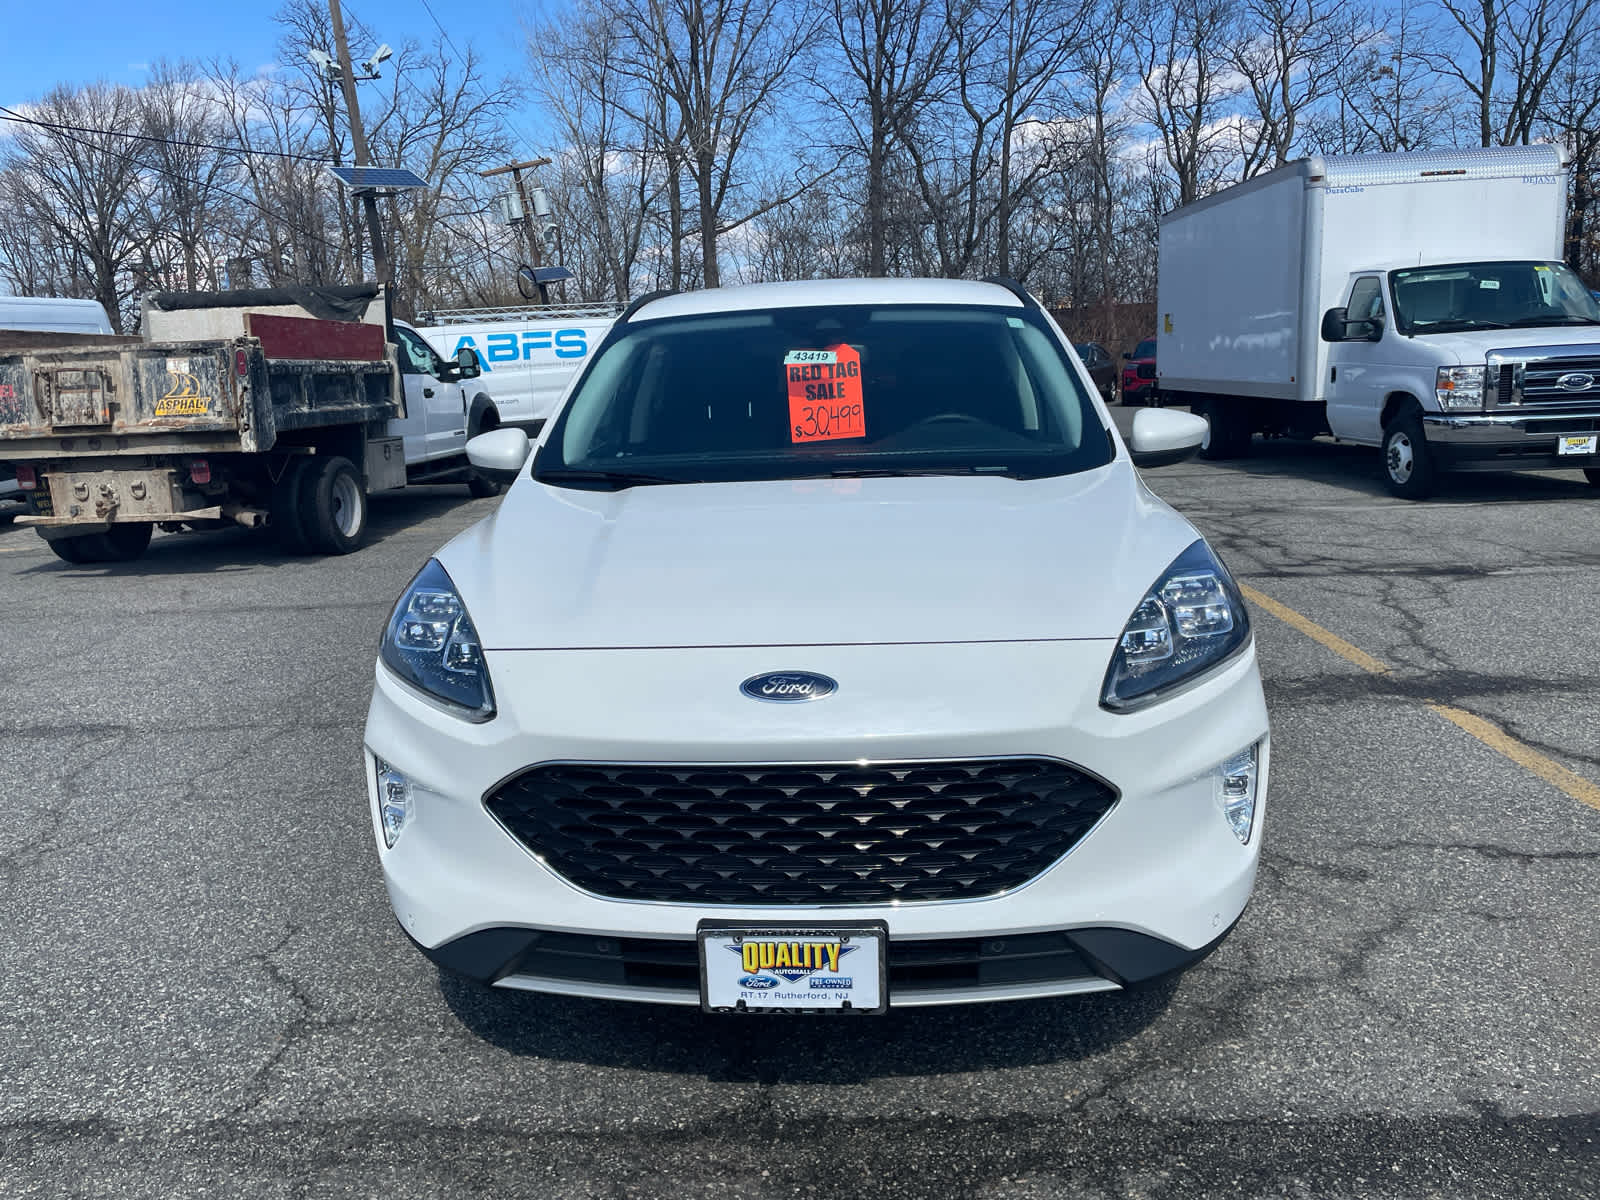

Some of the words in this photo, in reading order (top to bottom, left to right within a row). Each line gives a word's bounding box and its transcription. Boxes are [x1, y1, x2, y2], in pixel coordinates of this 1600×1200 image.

[1521, 175, 1557, 185] DEJANA
[1325, 185, 1365, 194] DuraCube
[451, 329, 588, 372] ABFS
[794, 352, 829, 361] 43419
[790, 365, 821, 382] RED
[827, 361, 858, 379] TAG
[805, 382, 845, 401] SALE
[158, 397, 211, 410] ASPHALT
[762, 675, 817, 694] Ford
[742, 942, 841, 974] QUALITY
[745, 977, 772, 988] Ford
[774, 991, 831, 1000] Rutherford,
[835, 992, 849, 1000] NJ
